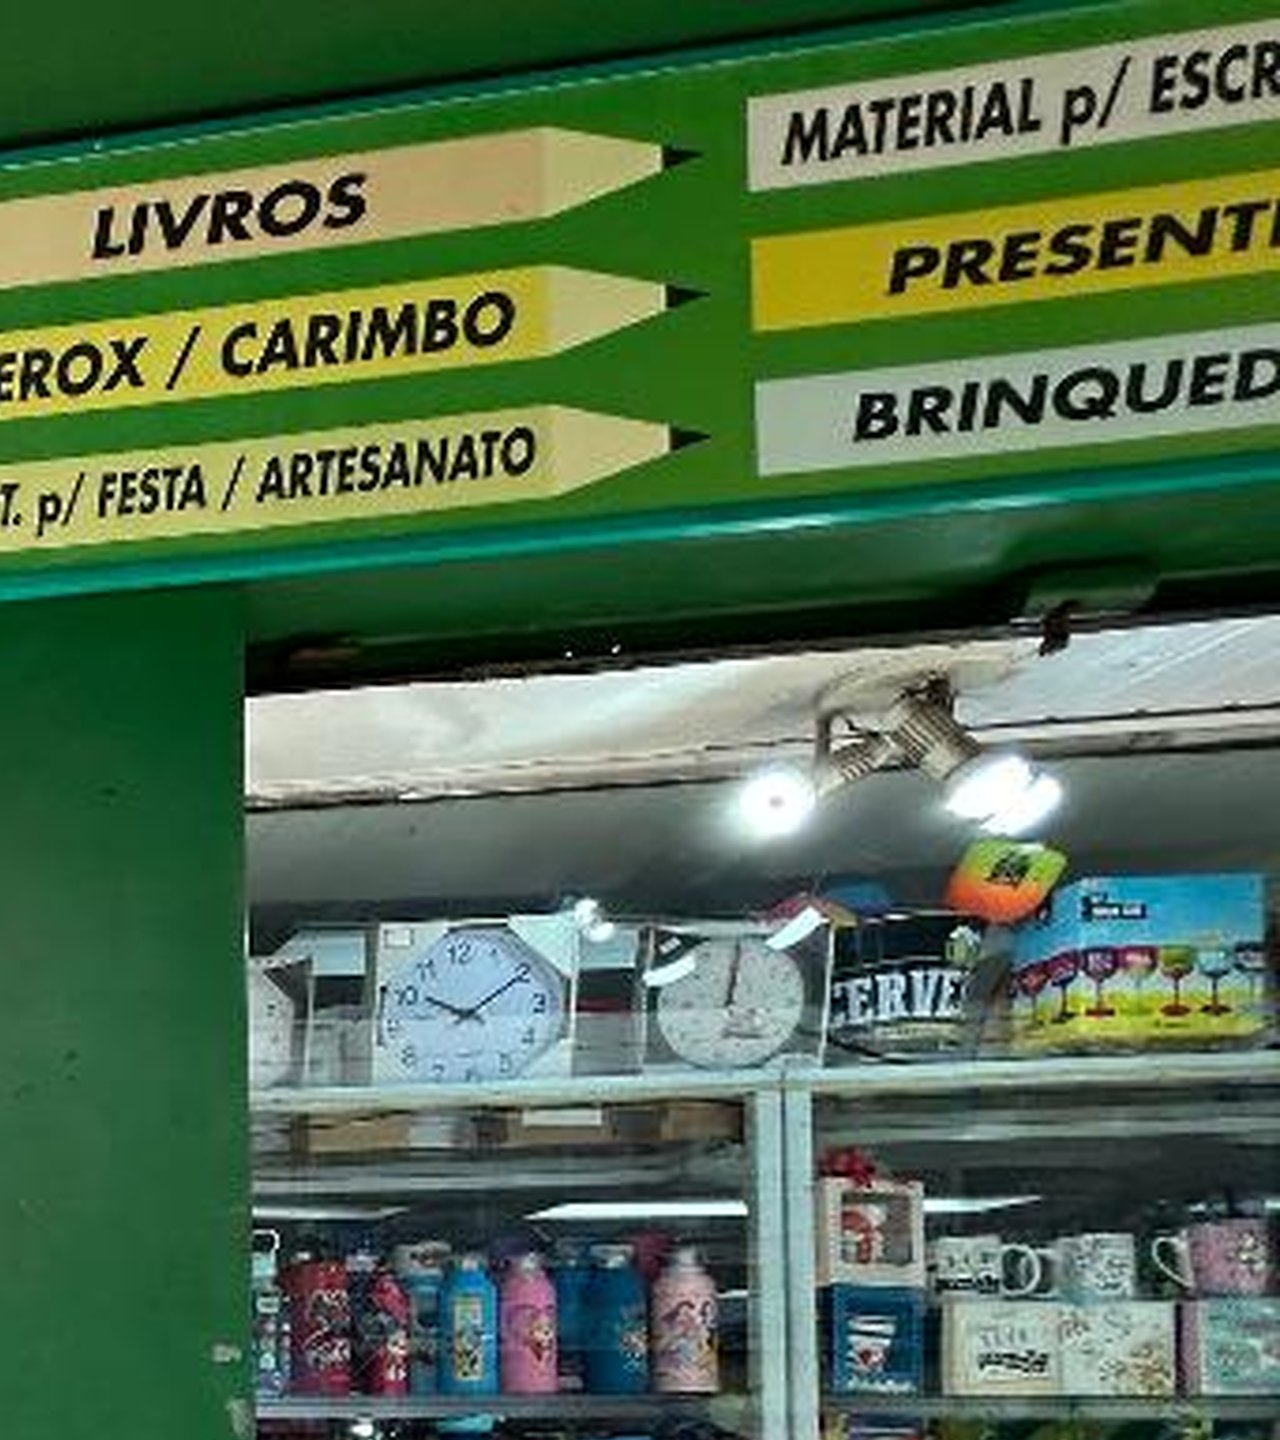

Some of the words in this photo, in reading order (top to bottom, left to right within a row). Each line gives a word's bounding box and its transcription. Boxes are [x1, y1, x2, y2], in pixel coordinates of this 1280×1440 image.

[780, 78, 1040, 165] MATERIAL
[1060, 56, 1131, 145] p/
[1149, 40, 1280, 114] ESCR
[91, 173, 368, 259] LIVROS
[220, 290, 516, 378] CARIMBO
[853, 348, 1280, 443] BRINQUED
[38, 471, 85, 536] p/
[97, 463, 208, 518] FESTA
[255, 426, 536, 502] ARTESANATO
[828, 970, 971, 1028] ERVE
